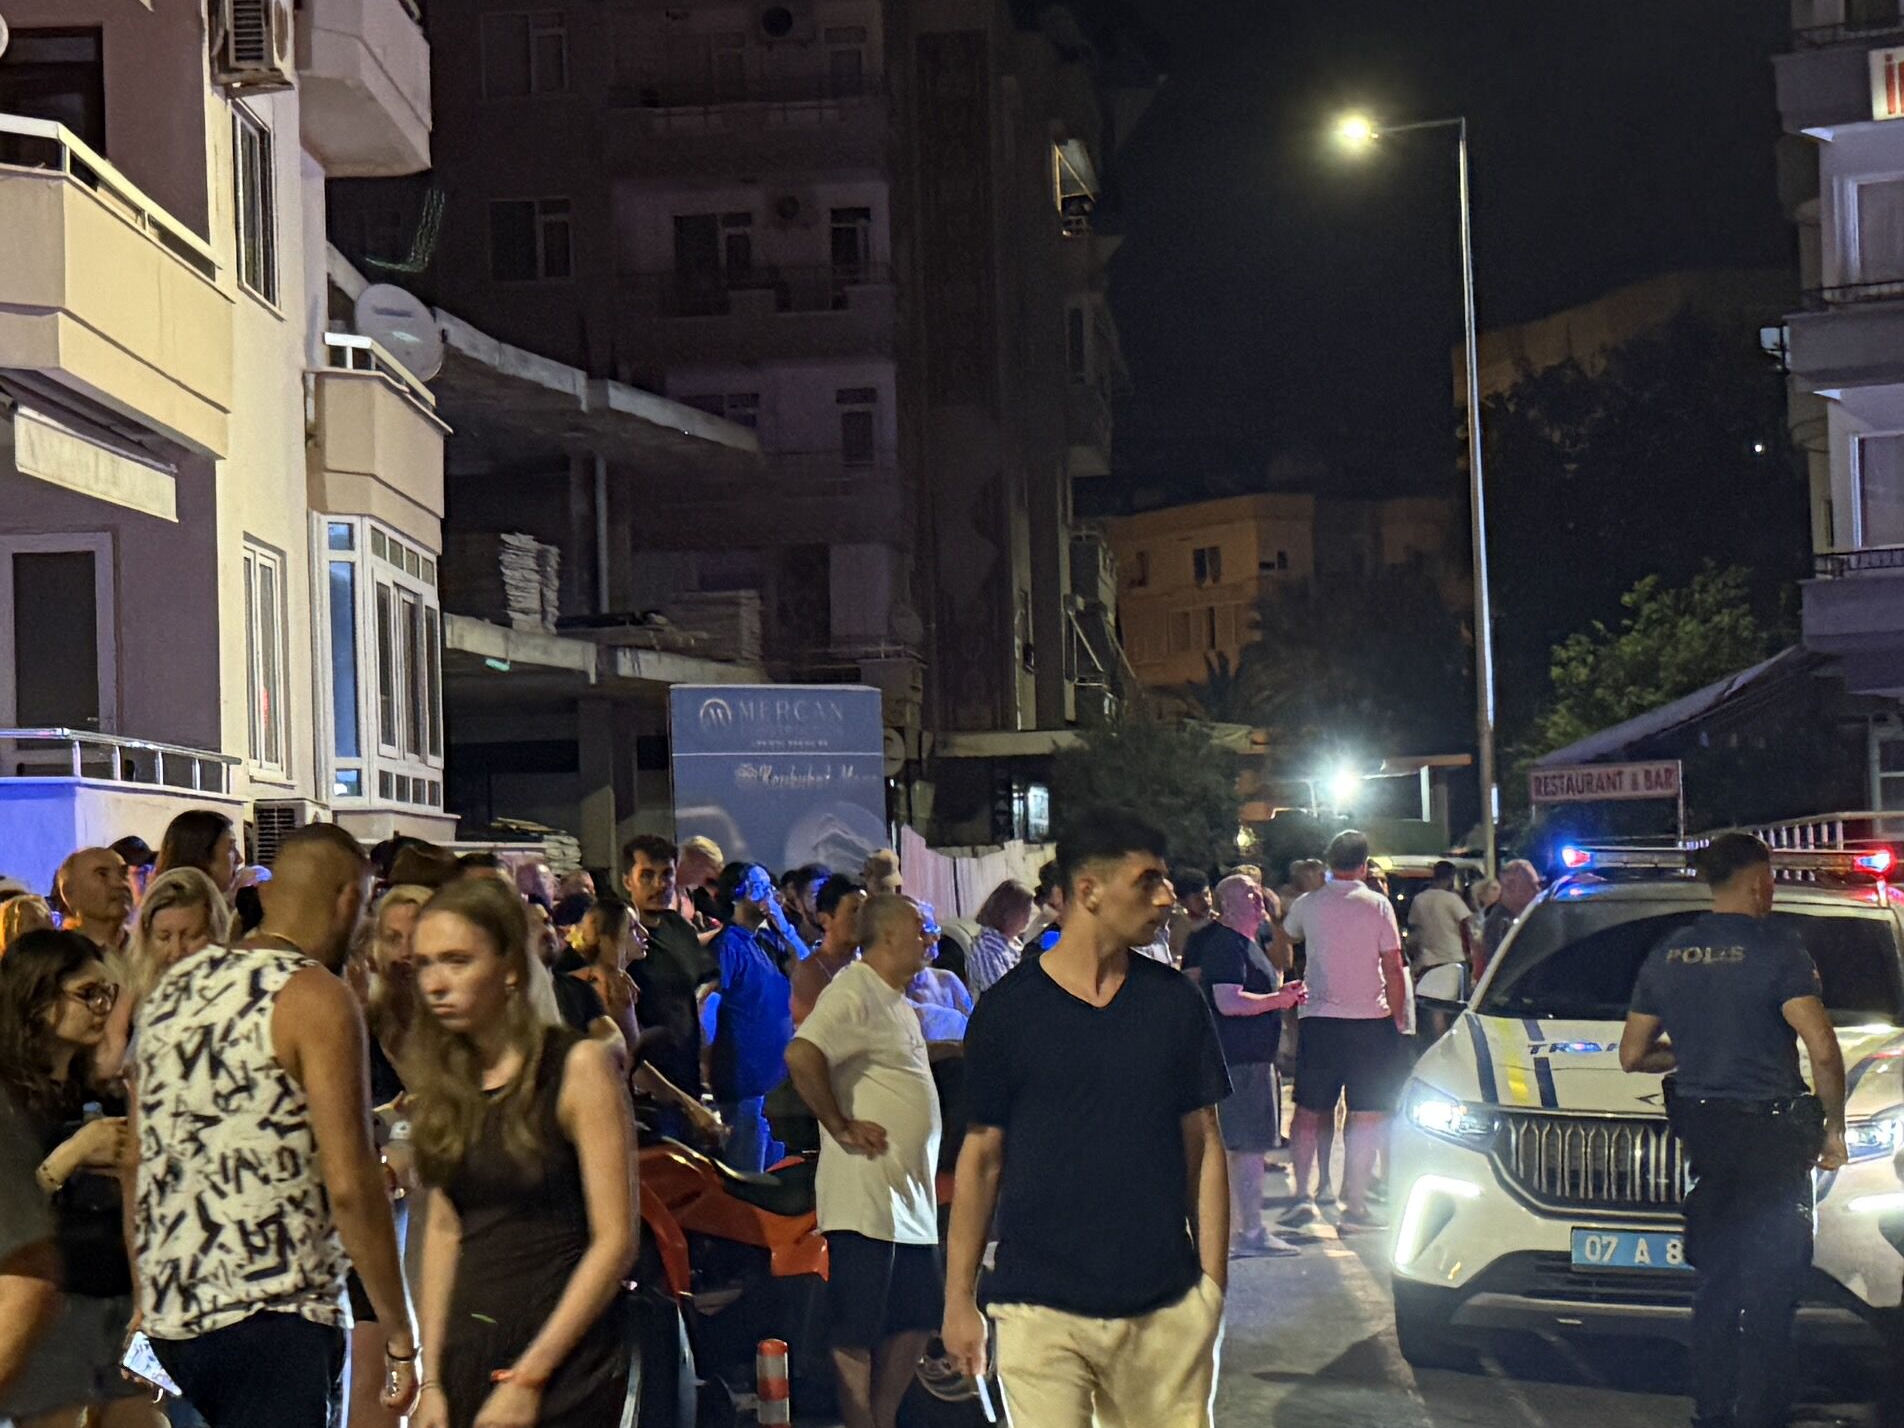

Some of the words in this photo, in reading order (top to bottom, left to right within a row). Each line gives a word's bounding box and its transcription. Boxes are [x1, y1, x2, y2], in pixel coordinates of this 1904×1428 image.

[1533, 770, 1625, 797] RESTAURANT
[1643, 767, 1675, 791] BAR
[1585, 1234, 1618, 1263] 07
[1634, 1237, 1652, 1265] A
